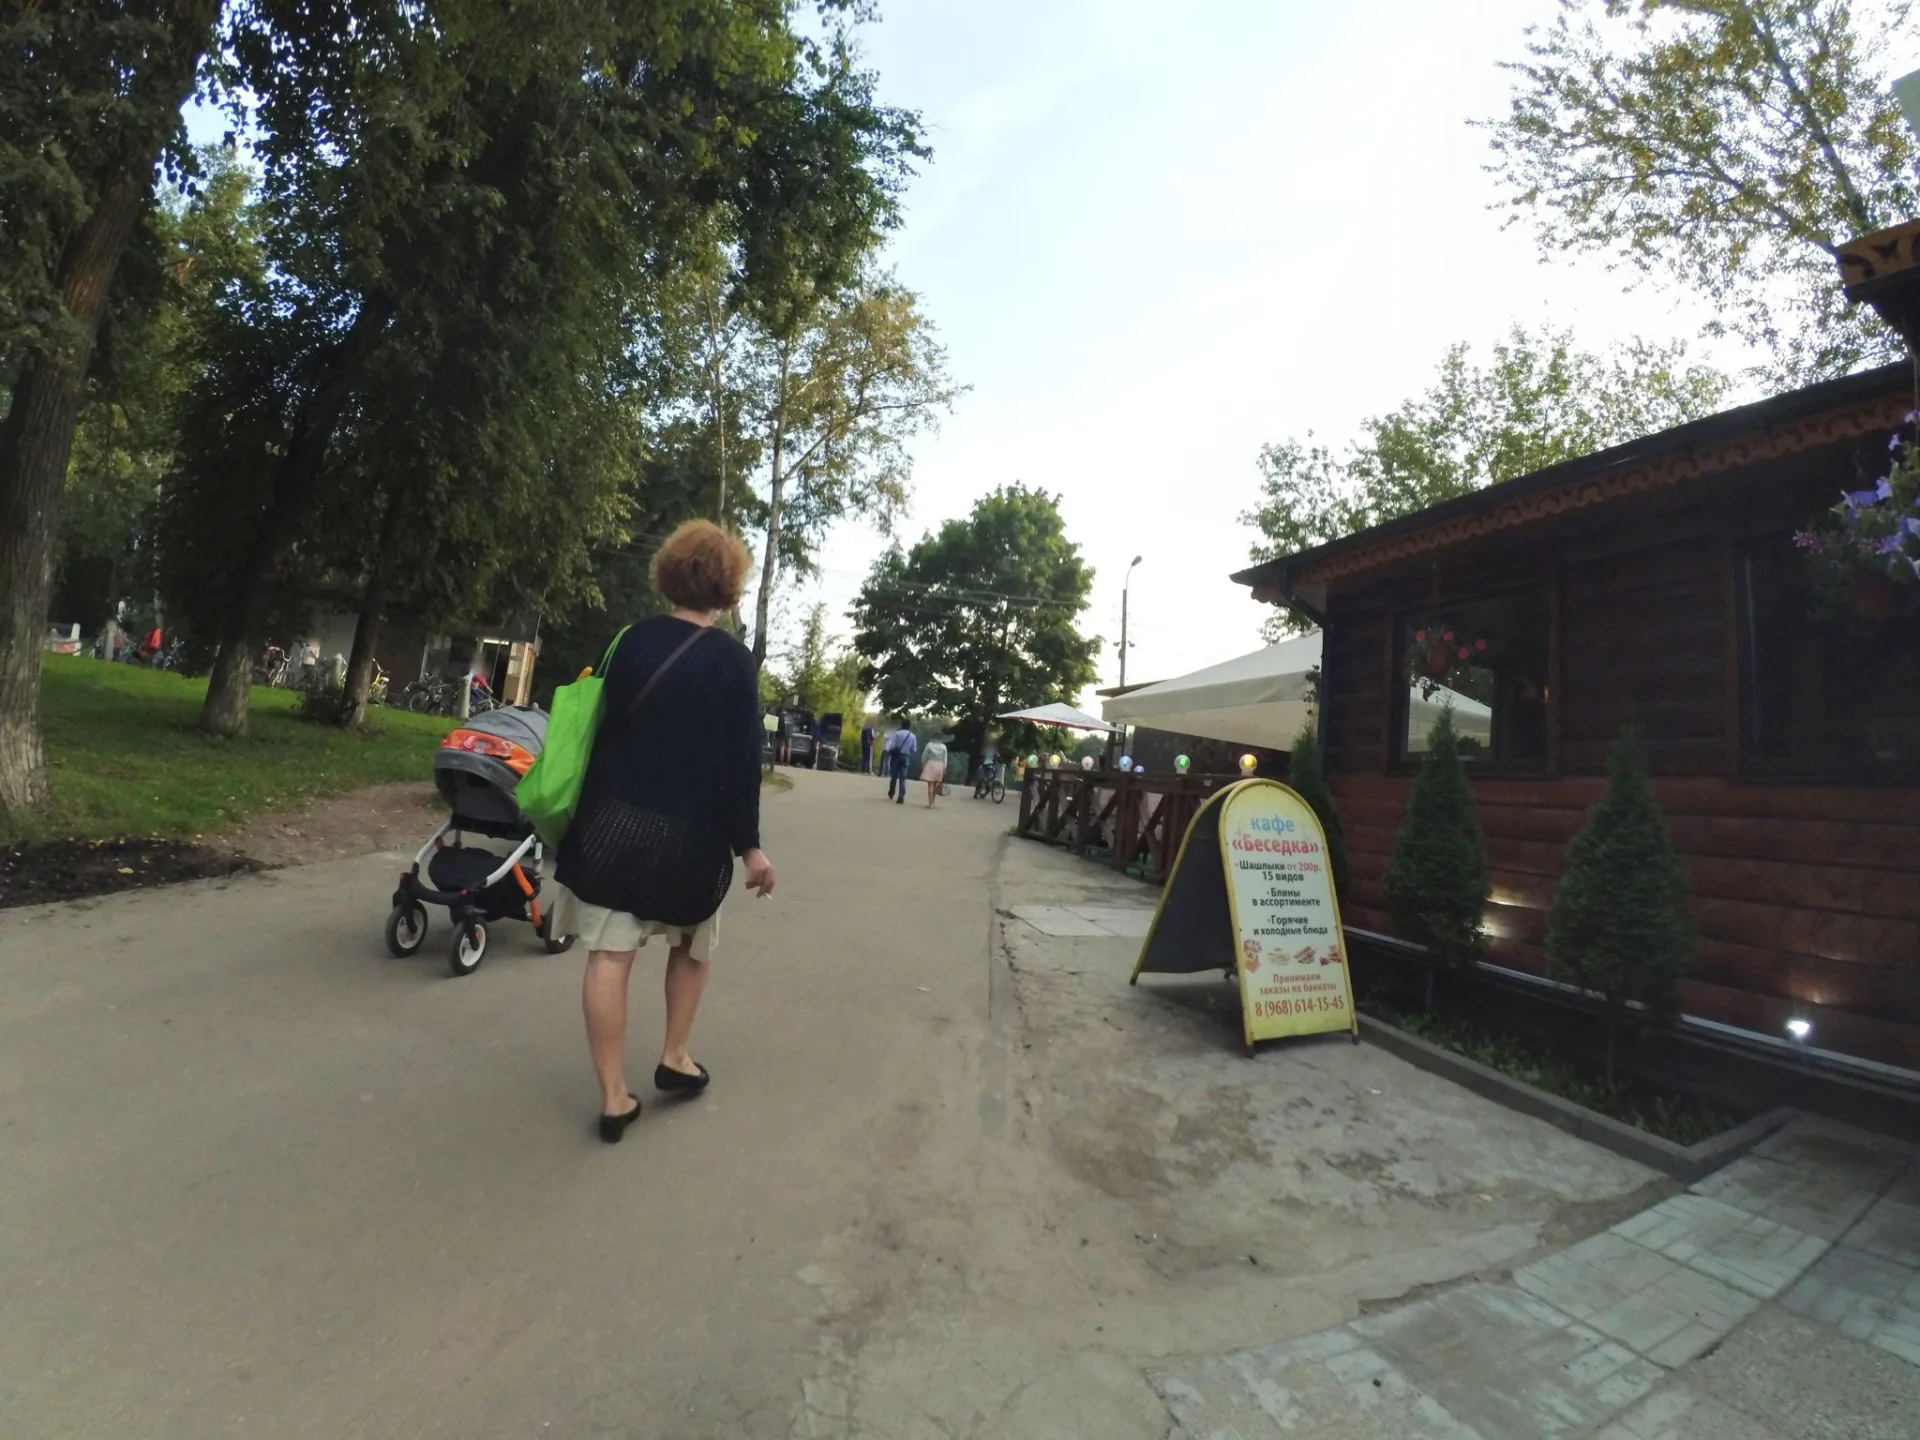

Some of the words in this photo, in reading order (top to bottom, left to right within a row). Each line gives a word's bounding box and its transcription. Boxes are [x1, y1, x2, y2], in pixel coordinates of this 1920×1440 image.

[1251, 814, 1295, 835] кафе
[1240, 860, 1285, 871] Шашлыки
[1287, 862, 1297, 871] от
[1298, 862, 1321, 873] 200р.
[1262, 871, 1273, 881] 15
[1276, 872, 1304, 882] видов
[1271, 887, 1300, 897] Блины
[1252, 898, 1258, 906] в
[1260, 898, 1320, 908] ассортименте
[1271, 915, 1308, 926] Горячие
[1253, 928, 1259, 936] и
[1261, 926, 1301, 937] холодные
[1303, 924, 1328, 935] блюда
[1273, 973, 1321, 984] Принимаем
[1259, 985, 1290, 996] заказы
[1292, 985, 1301, 993] на
[1303, 982, 1336, 992] банкеты
[1255, 1002, 1263, 1016] 8
[1265, 999, 1292, 1018] (968)
[1295, 995, 1344, 1013] 614-15-45
